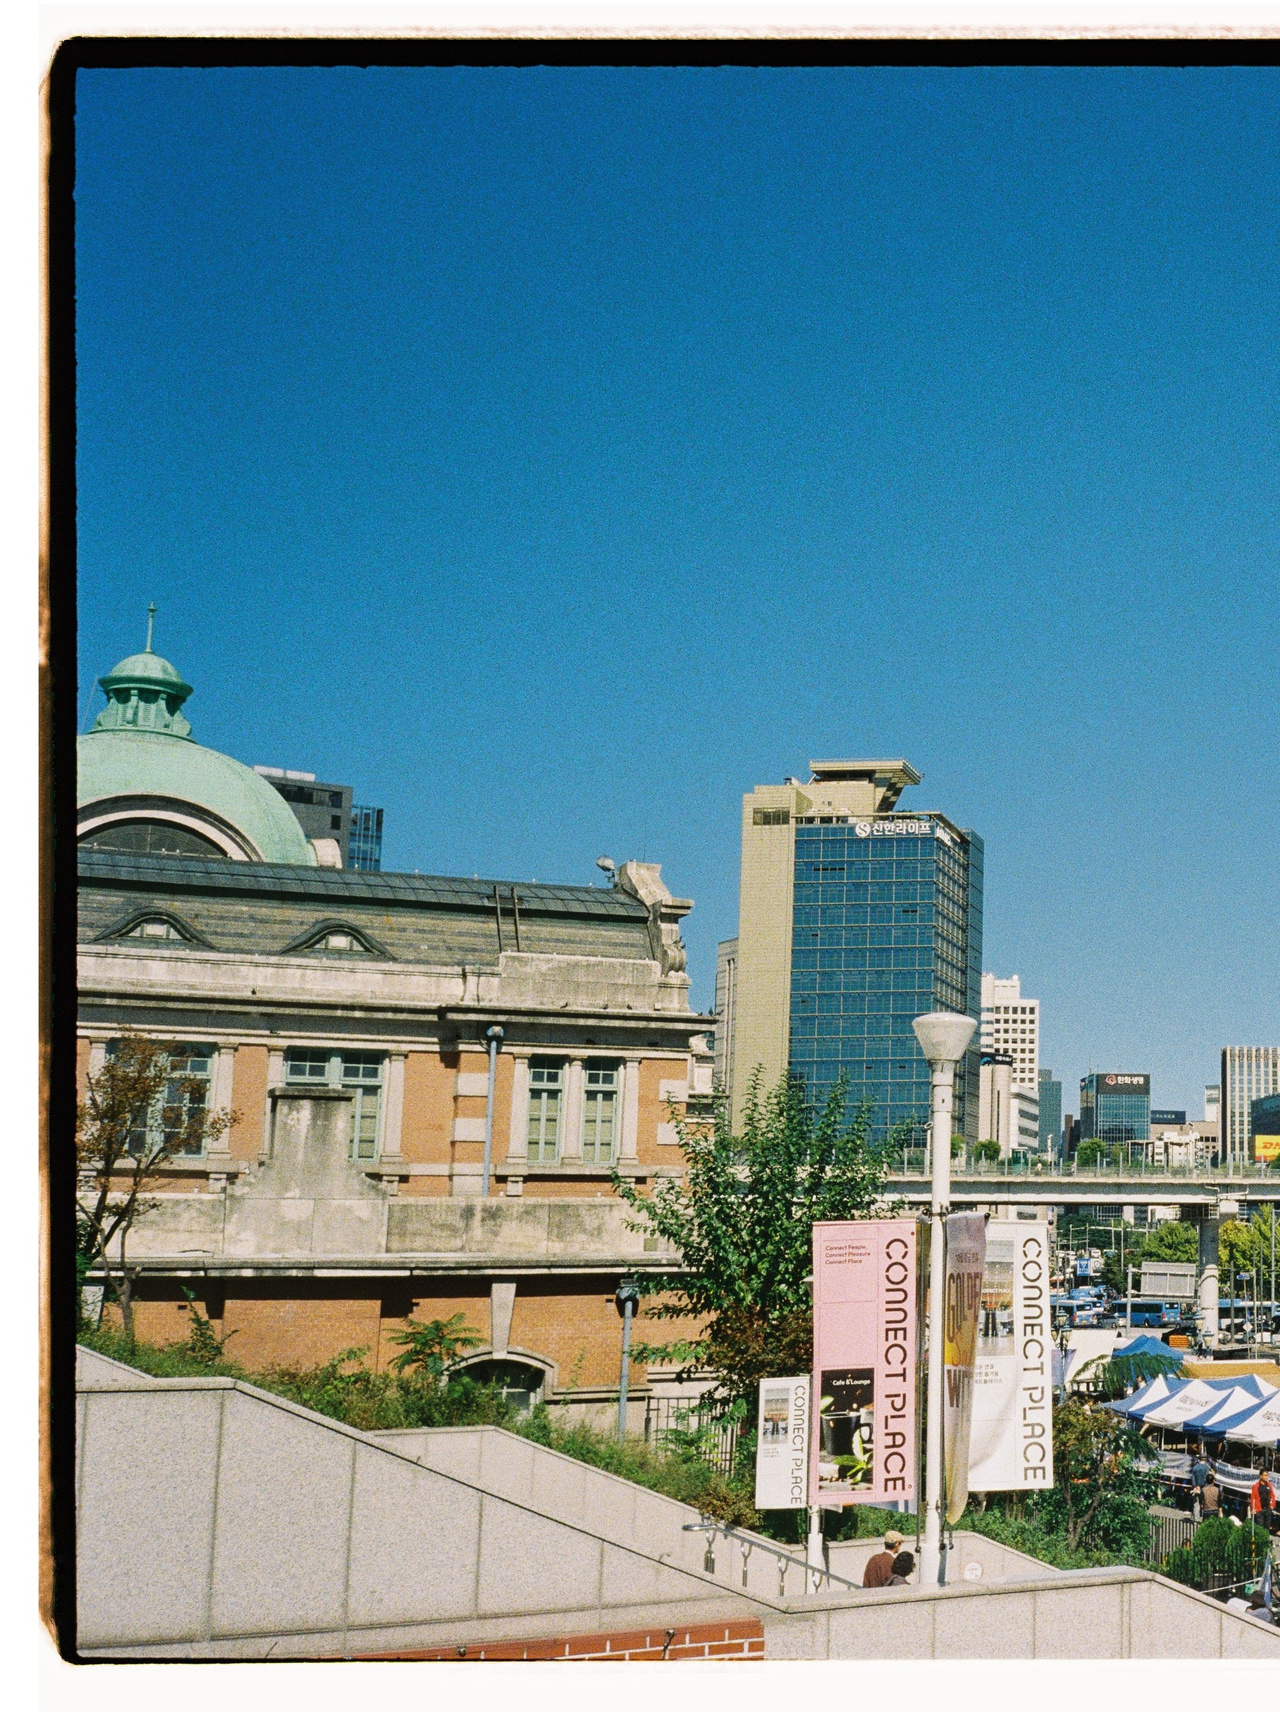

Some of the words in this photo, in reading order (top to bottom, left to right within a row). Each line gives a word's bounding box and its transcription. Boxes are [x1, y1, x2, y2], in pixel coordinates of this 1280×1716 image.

[872, 821, 931, 836] 신한라이프
[1117, 1076, 1144, 1085] 한화생명
[884, 1238, 908, 1382] CONNECT
[1022, 1238, 1045, 1380] CONNECT
[792, 1385, 806, 1453] CONNECT
[883, 1393, 907, 1492] PLACE
[1022, 1386, 1046, 1481] PLACE
[791, 1458, 804, 1504] PLACE
